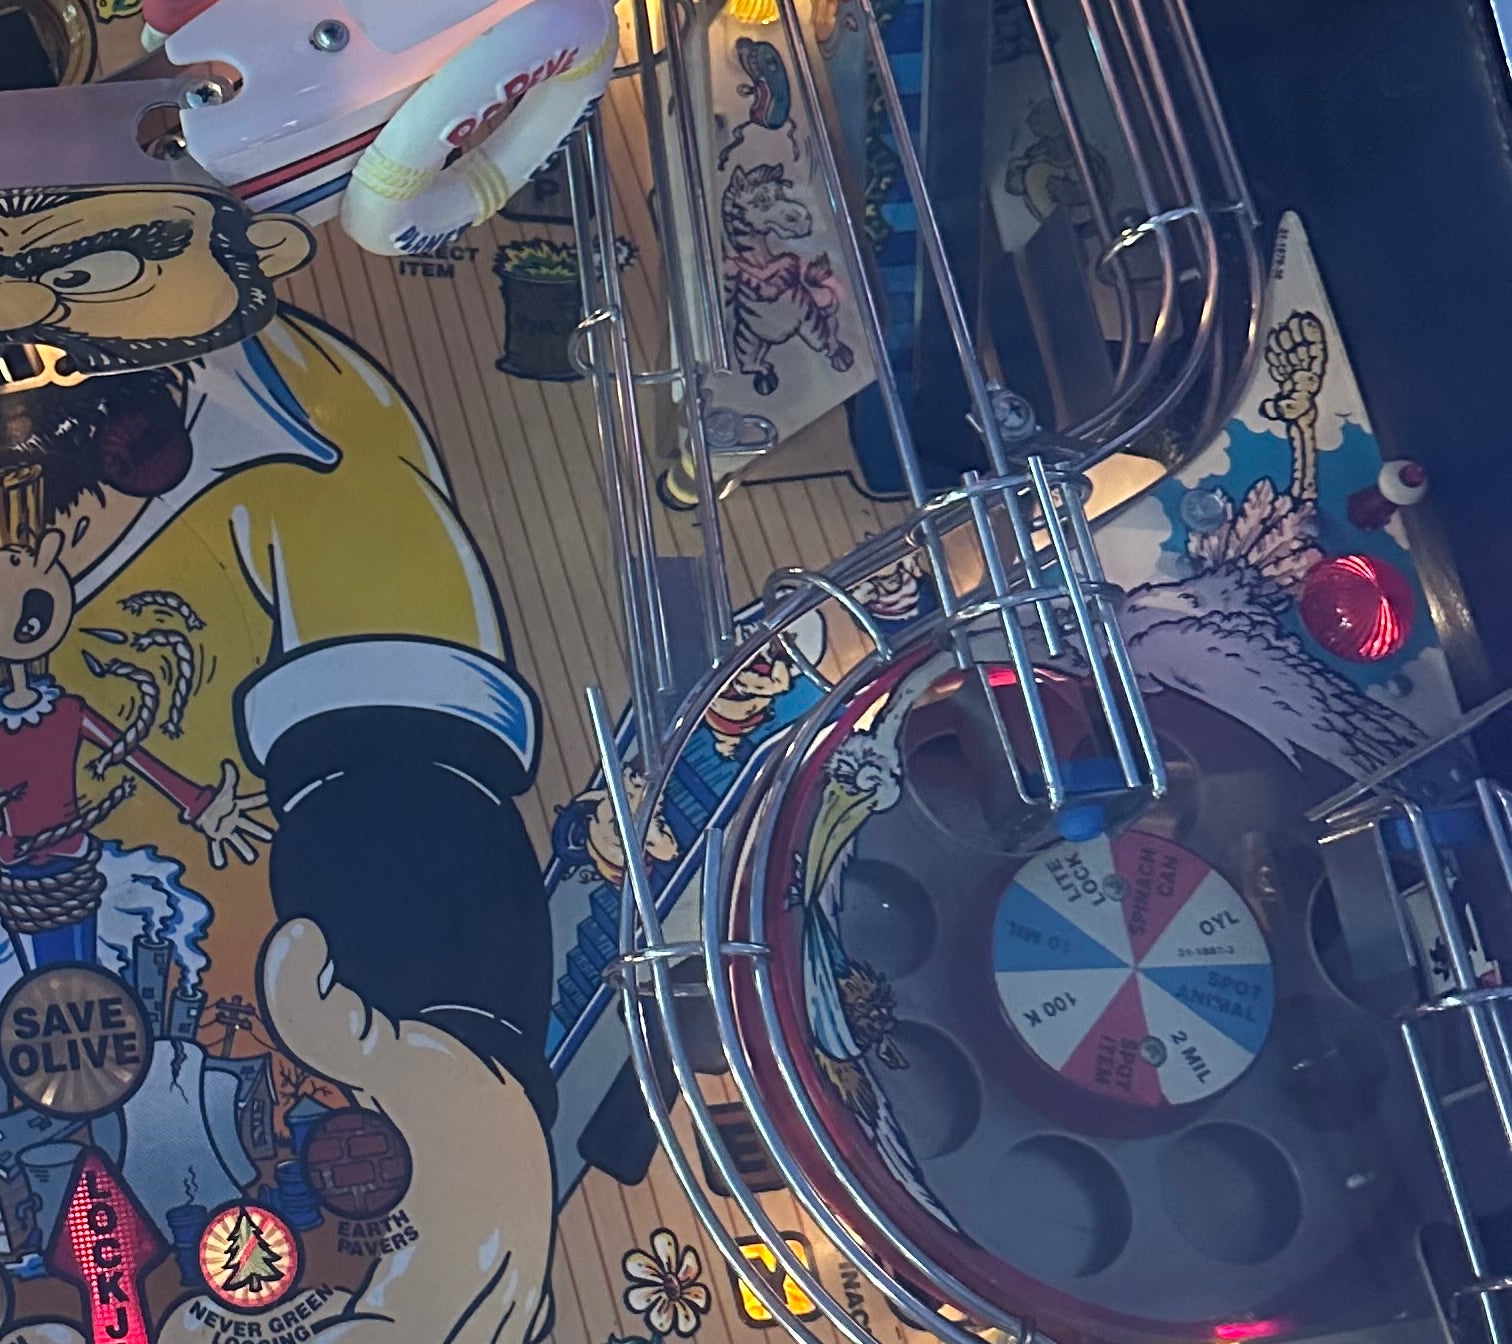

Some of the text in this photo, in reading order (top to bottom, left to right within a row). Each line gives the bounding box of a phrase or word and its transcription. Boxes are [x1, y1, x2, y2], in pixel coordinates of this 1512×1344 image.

[398, 259, 456, 280] ITEM
[1045, 857, 1083, 903] LITE
[1066, 851, 1107, 907] LOCK
[1198, 908, 1241, 936] OYL
[11, 997, 128, 1040] SAVE
[1043, 990, 1077, 1018] 100
[8, 1031, 141, 1077] OLIVE
[1171, 1029, 1214, 1085] 2 MIL
[337, 1209, 410, 1241] EARTH
[337, 1224, 420, 1258] PAVERS
[189, 1282, 336, 1341] NEVER GREEN
